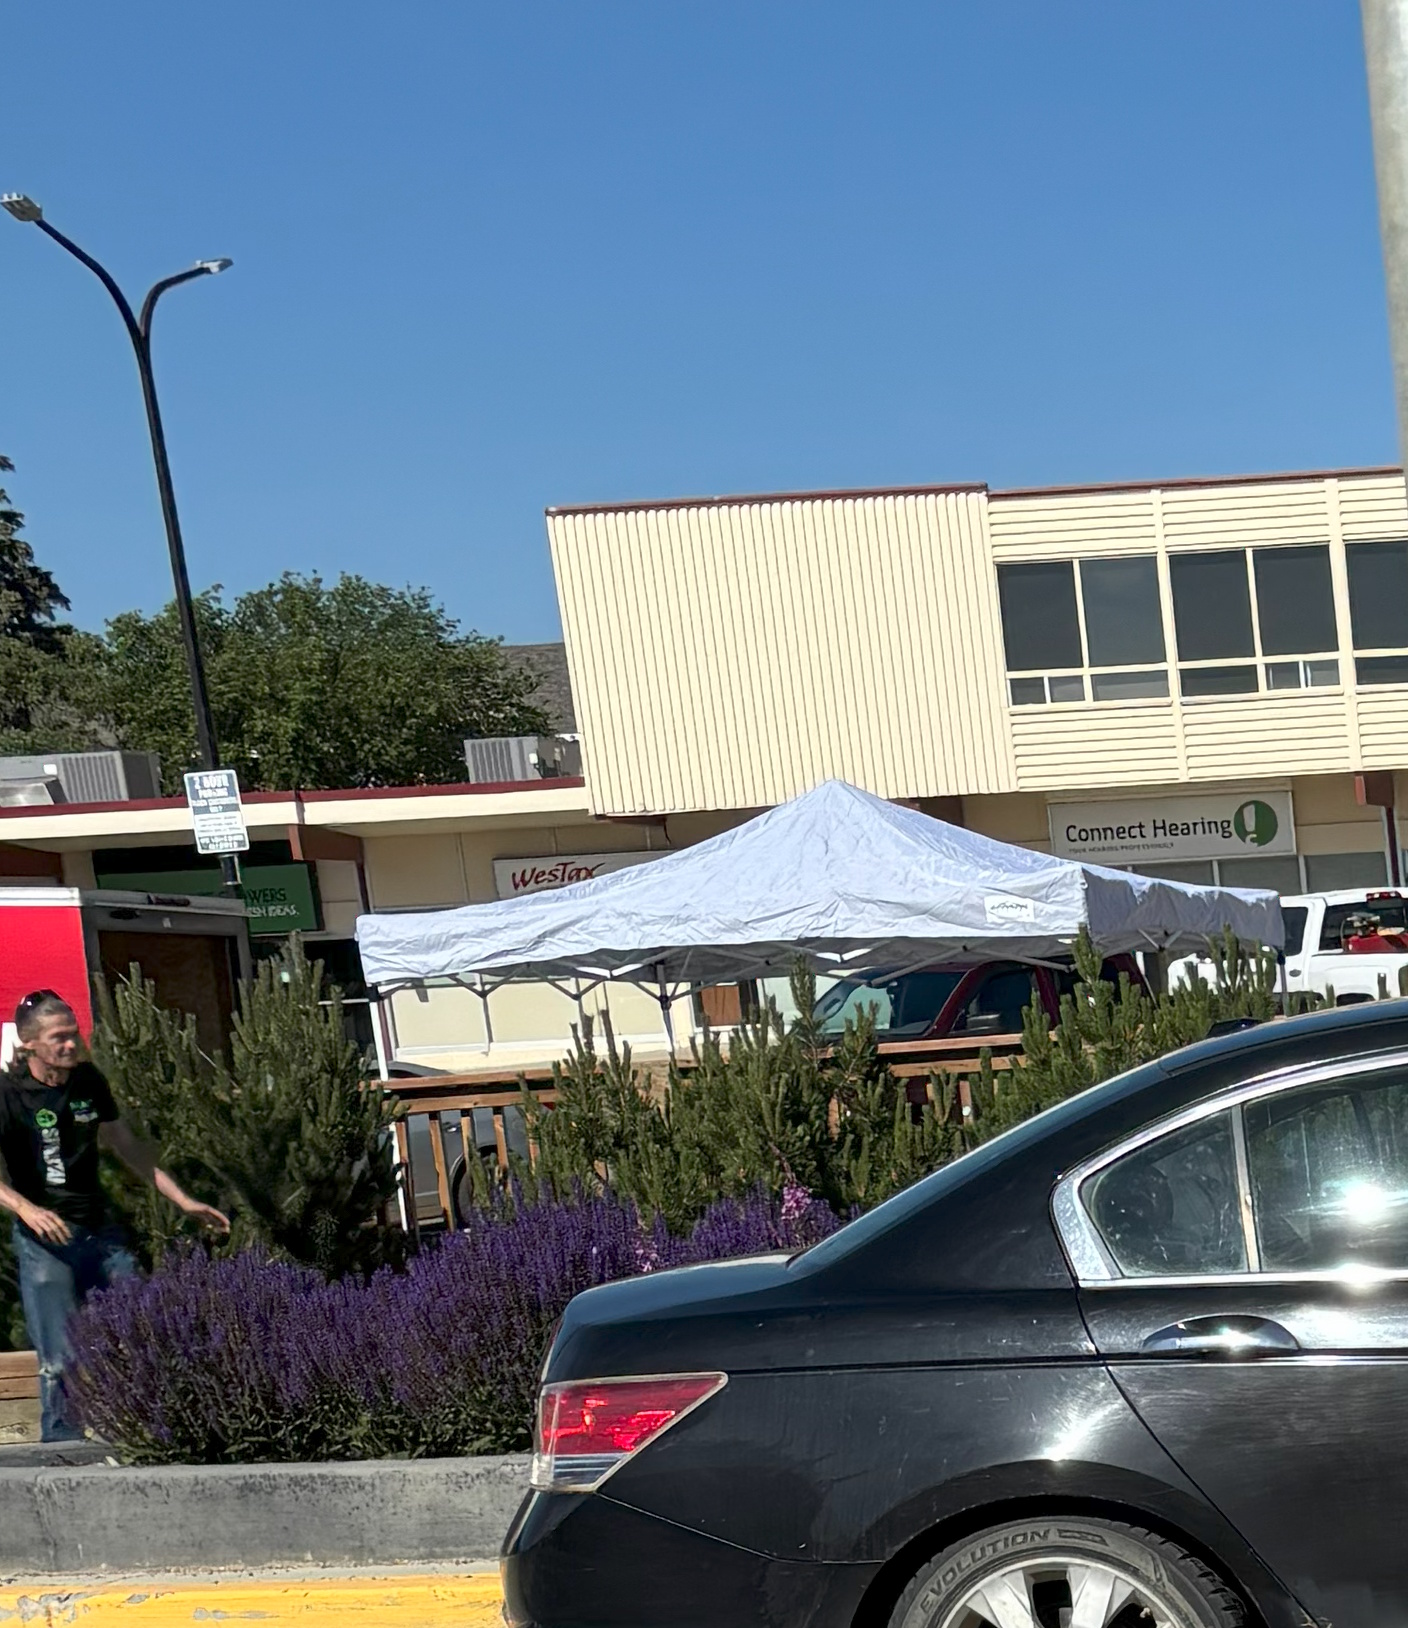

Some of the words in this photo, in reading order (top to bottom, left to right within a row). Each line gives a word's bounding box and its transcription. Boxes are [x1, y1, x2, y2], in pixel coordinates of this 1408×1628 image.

[1065, 821, 1146, 843] Connect
[1152, 816, 1233, 840] Hearing
[920, 1528, 1050, 1615] EVOLUTION
